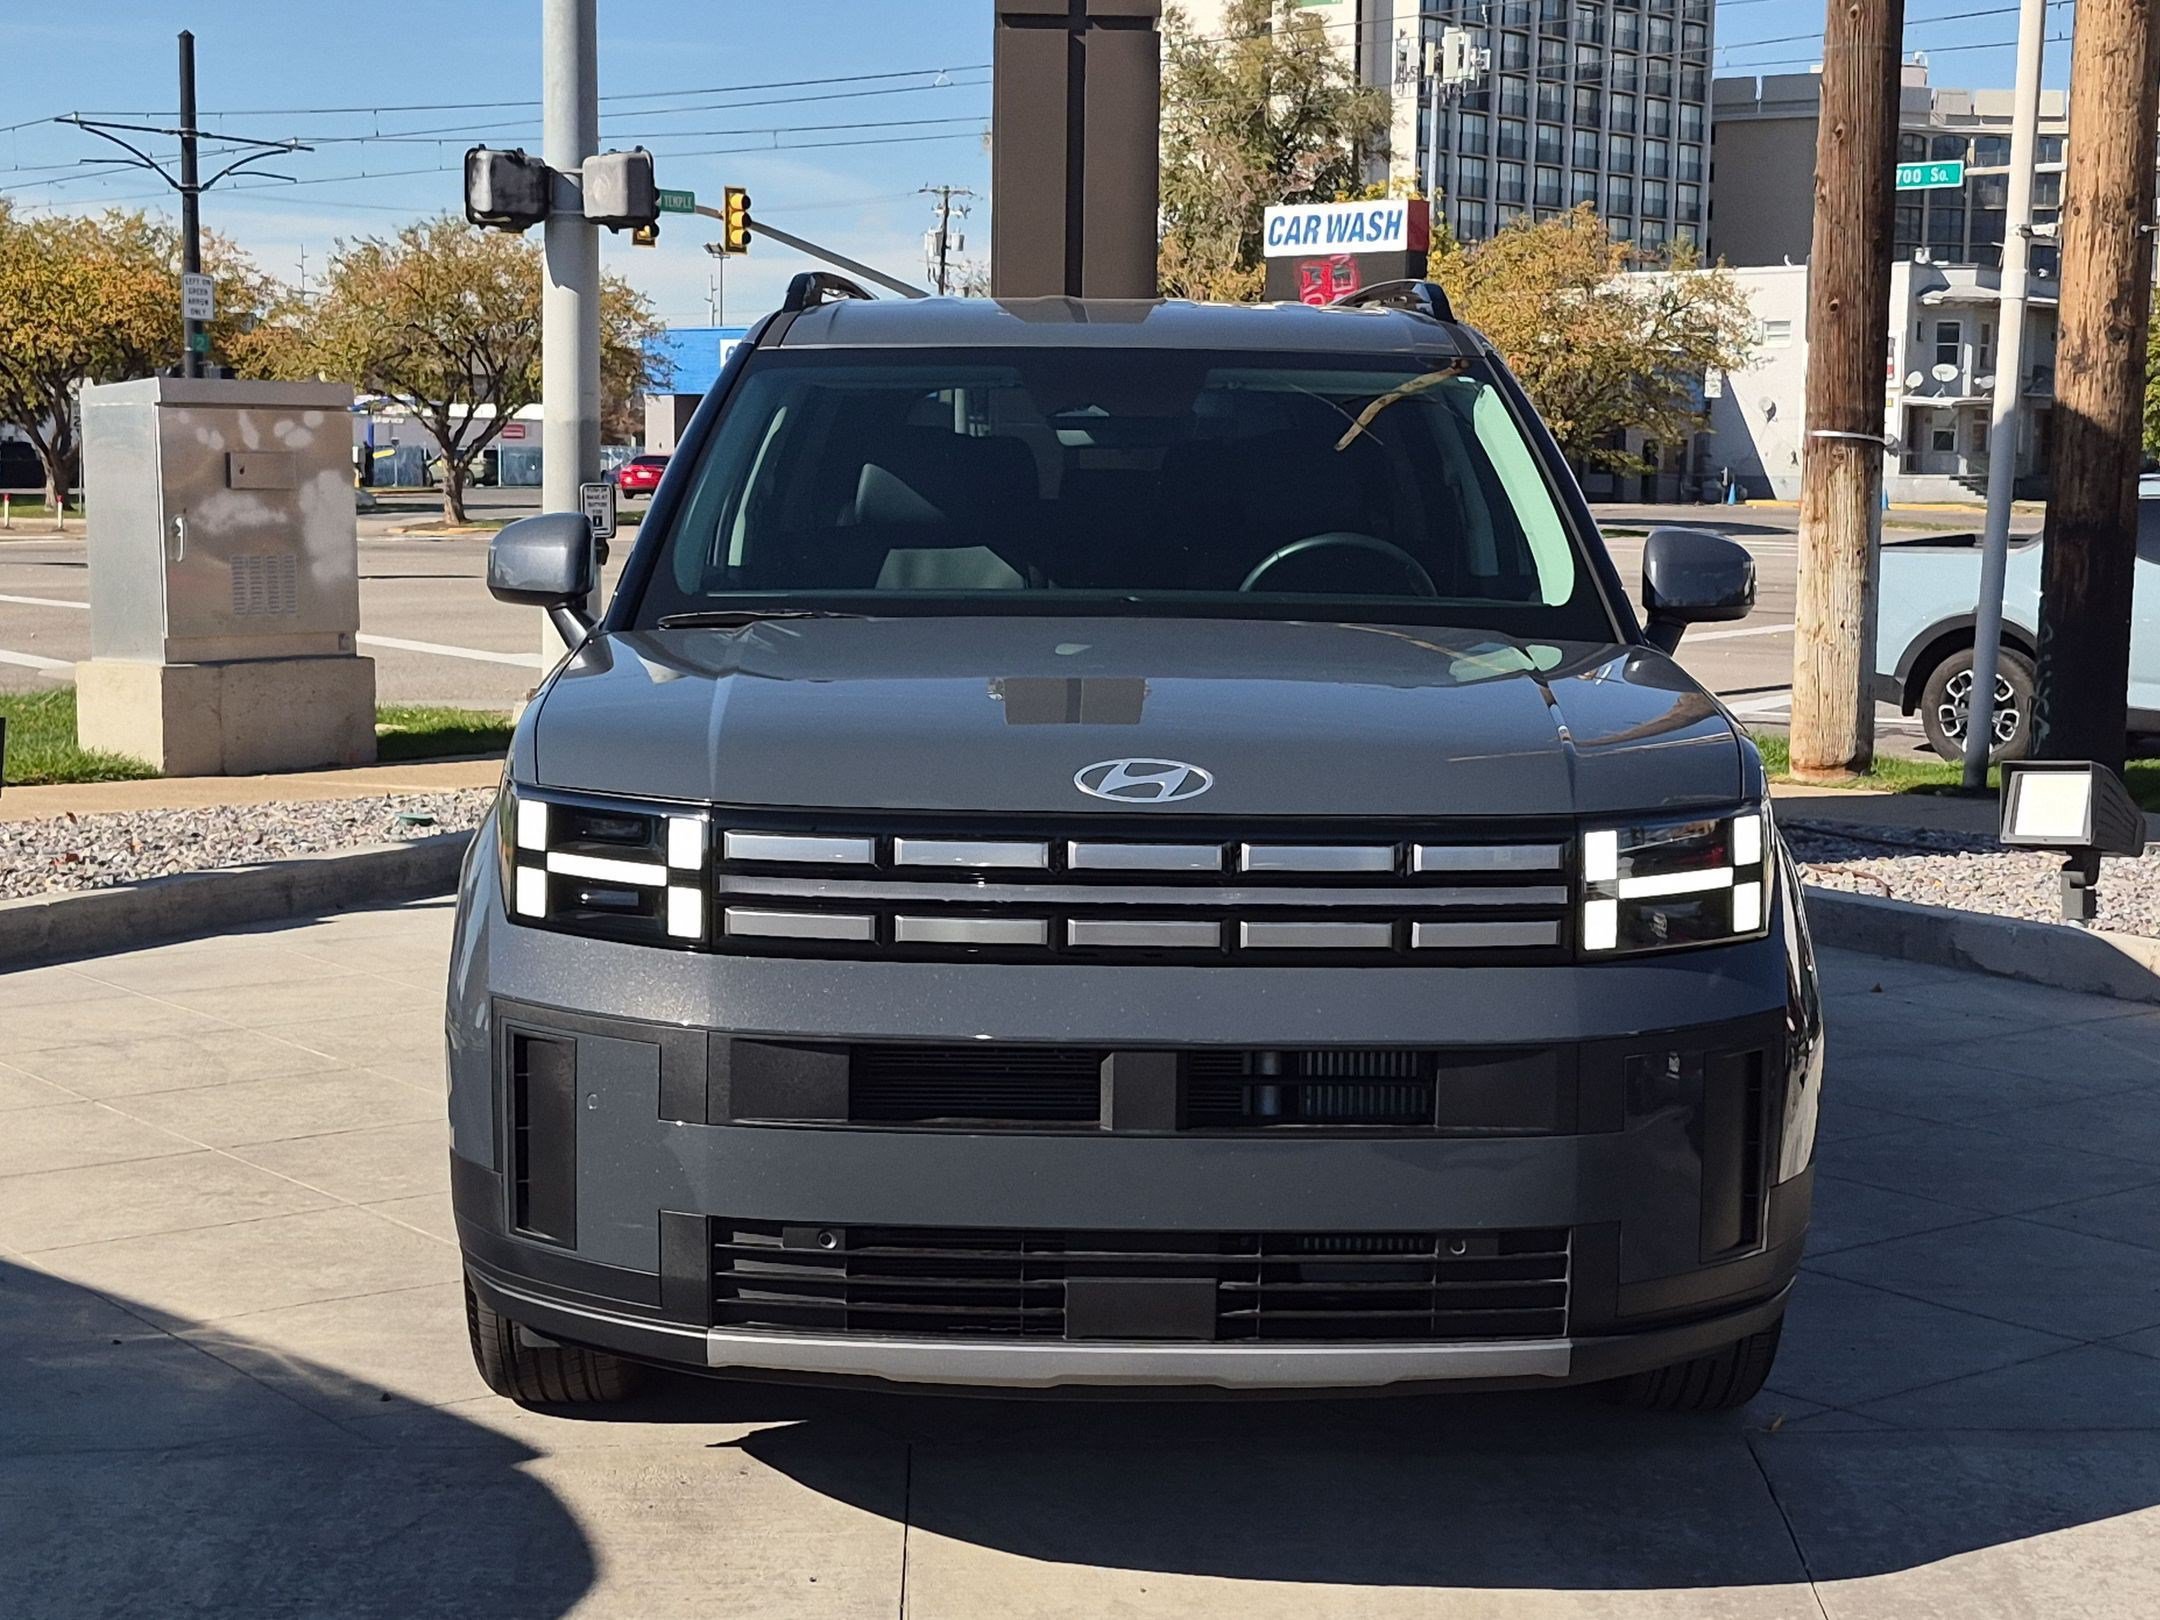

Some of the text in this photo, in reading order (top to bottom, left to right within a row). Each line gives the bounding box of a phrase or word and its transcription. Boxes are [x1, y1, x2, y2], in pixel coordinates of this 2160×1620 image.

[1896, 166, 1949, 185] 700 So.
[664, 194, 693, 209] TEMPLE
[1267, 209, 1403, 247] CAR WASH
[185, 277, 200, 286] LEFT
[188, 287, 208, 296] GREEN
[188, 298, 209, 307] ARROW
[190, 307, 206, 316] ONLY
